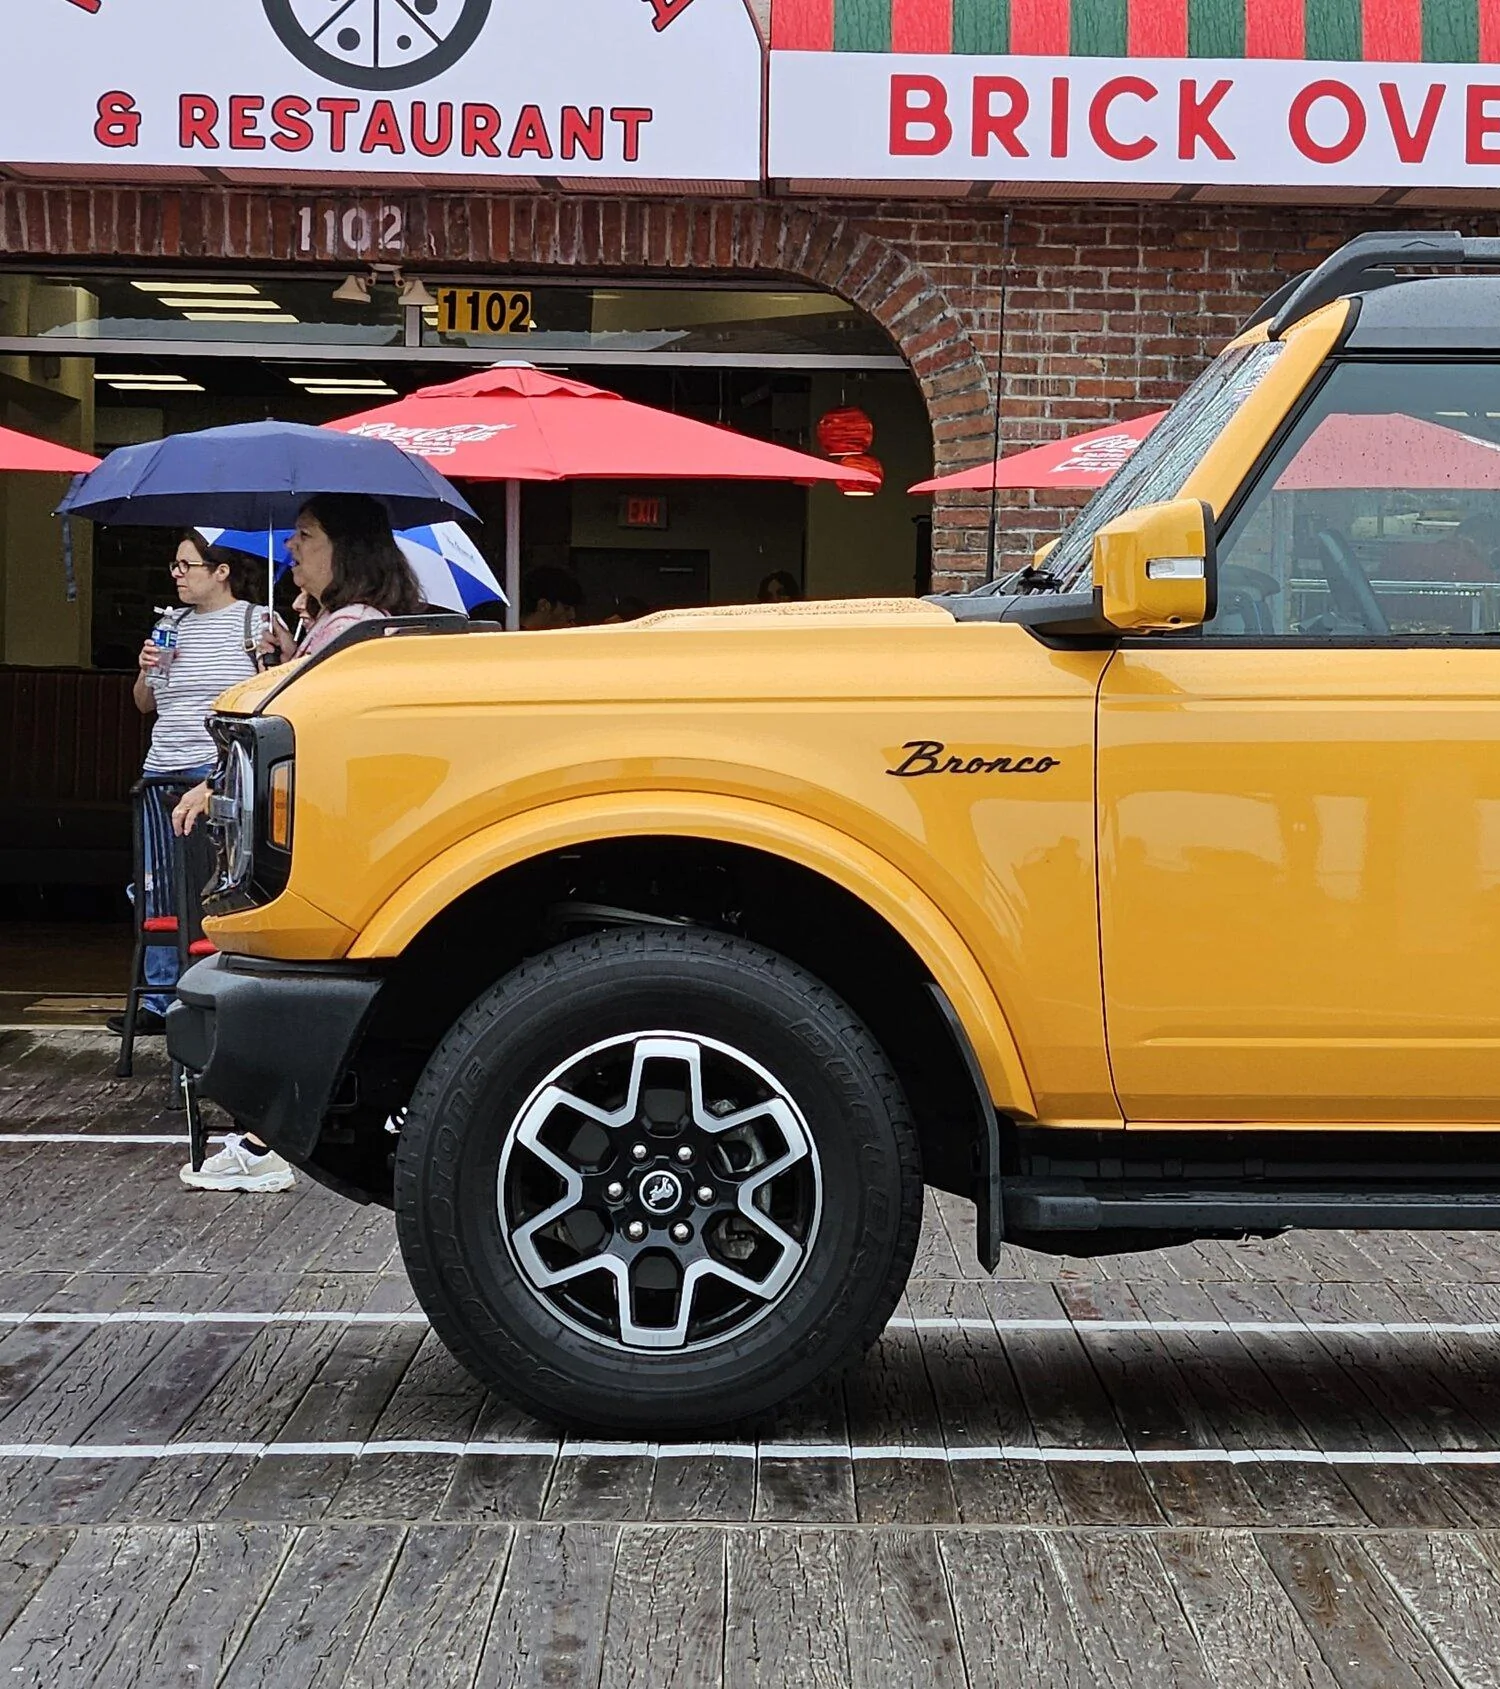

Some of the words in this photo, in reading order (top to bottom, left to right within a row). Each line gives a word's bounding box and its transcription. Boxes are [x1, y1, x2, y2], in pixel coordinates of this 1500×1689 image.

[94, 90, 141, 147] &
[178, 94, 653, 162] RESTAURANT
[889, 74, 1236, 161] BRICK
[299, 205, 402, 254] 1102
[443, 290, 530, 332] 1102
[627, 499, 659, 525] EXIT
[885, 740, 1061, 777] Bronco
